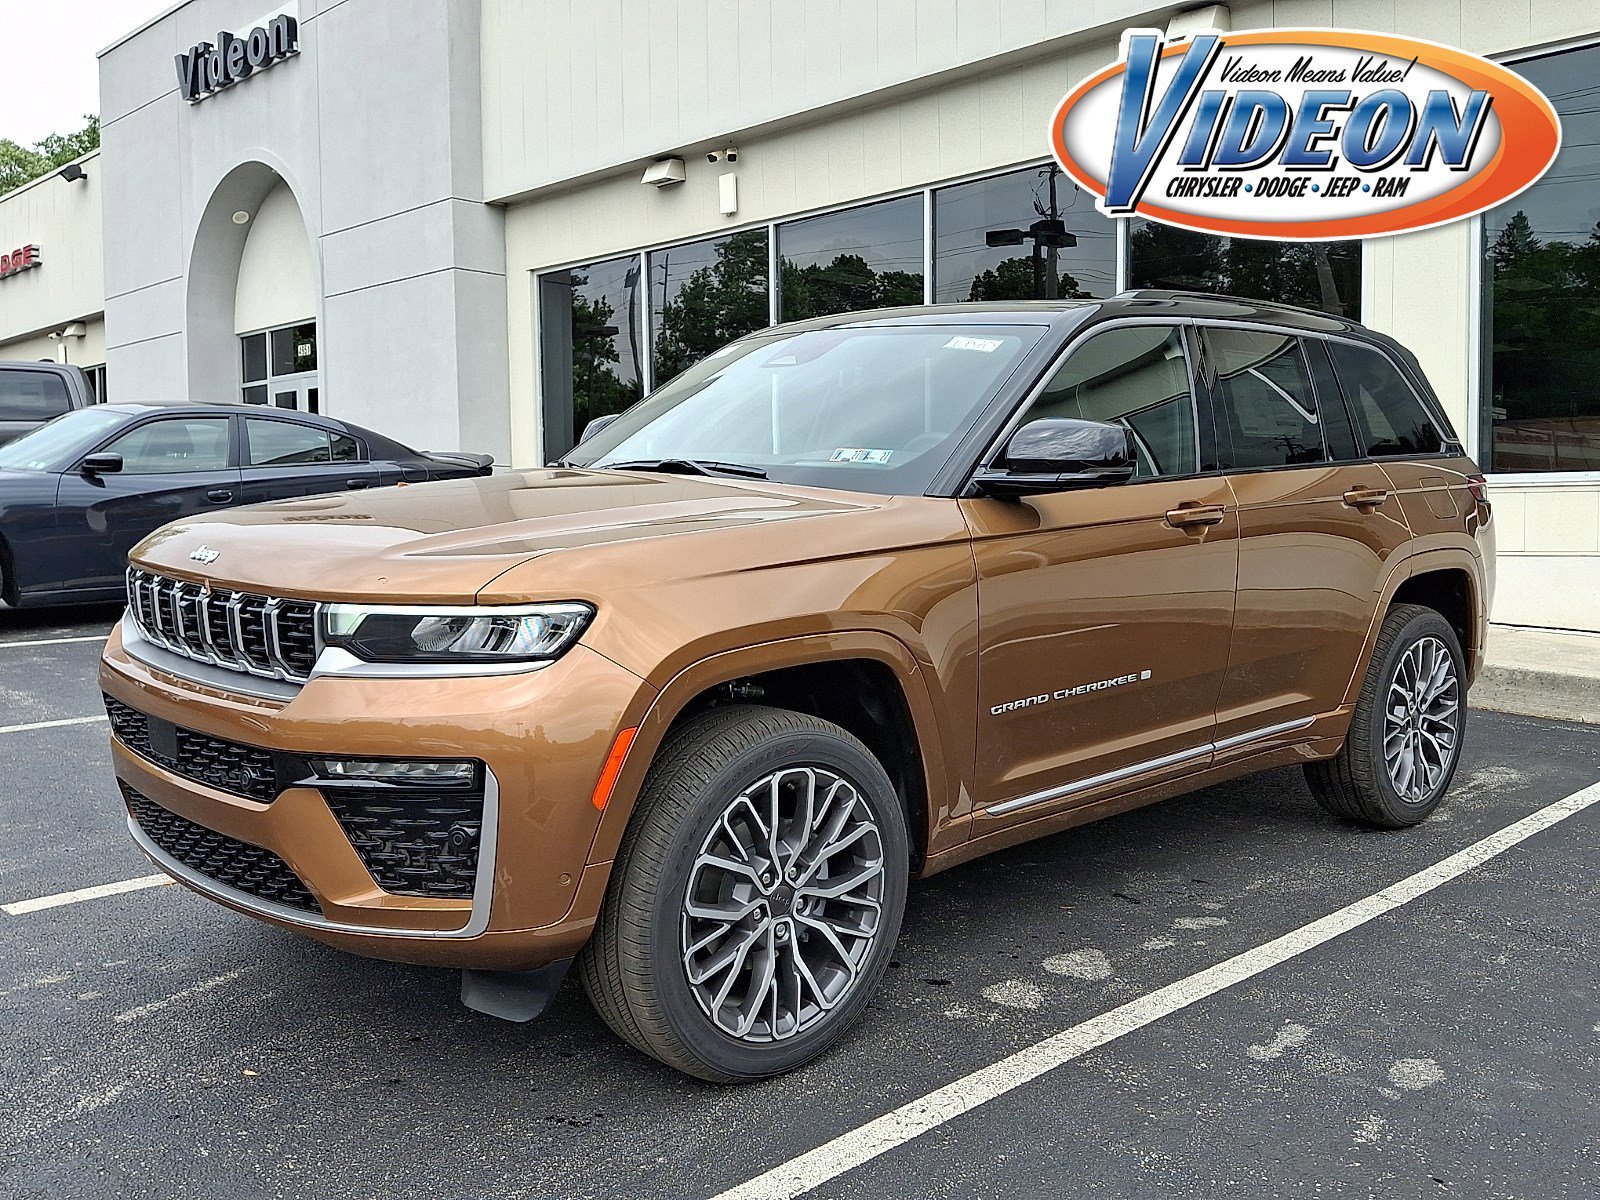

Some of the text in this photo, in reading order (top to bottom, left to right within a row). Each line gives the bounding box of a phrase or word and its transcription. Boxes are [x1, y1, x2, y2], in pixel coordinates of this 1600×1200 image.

[174, 13, 298, 102] Videon
[190, 544, 221, 566] Jeep
[990, 673, 1138, 716] GRAND CHEROKEE
